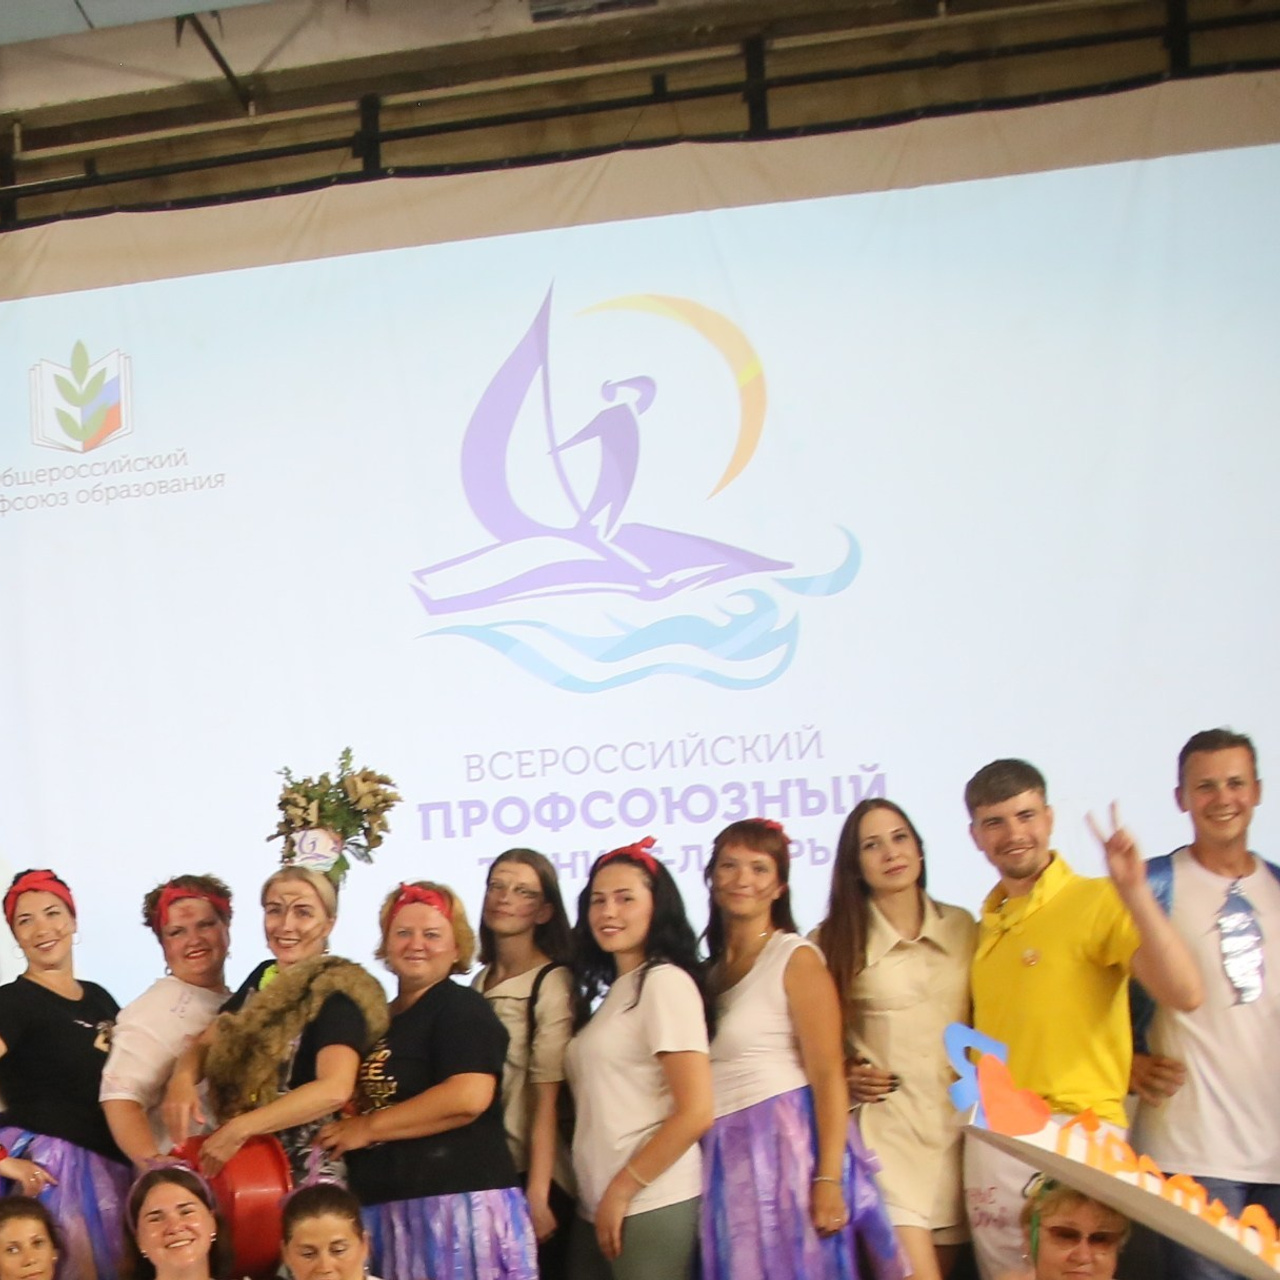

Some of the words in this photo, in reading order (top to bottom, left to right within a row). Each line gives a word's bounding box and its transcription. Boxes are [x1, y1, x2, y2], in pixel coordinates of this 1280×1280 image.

[77, 472, 226, 506] образования
[465, 726, 824, 782] ВСЕРОССИЙСКИЙ
[418, 765, 887, 840] ПРОФСОЮЗНЫЙ
